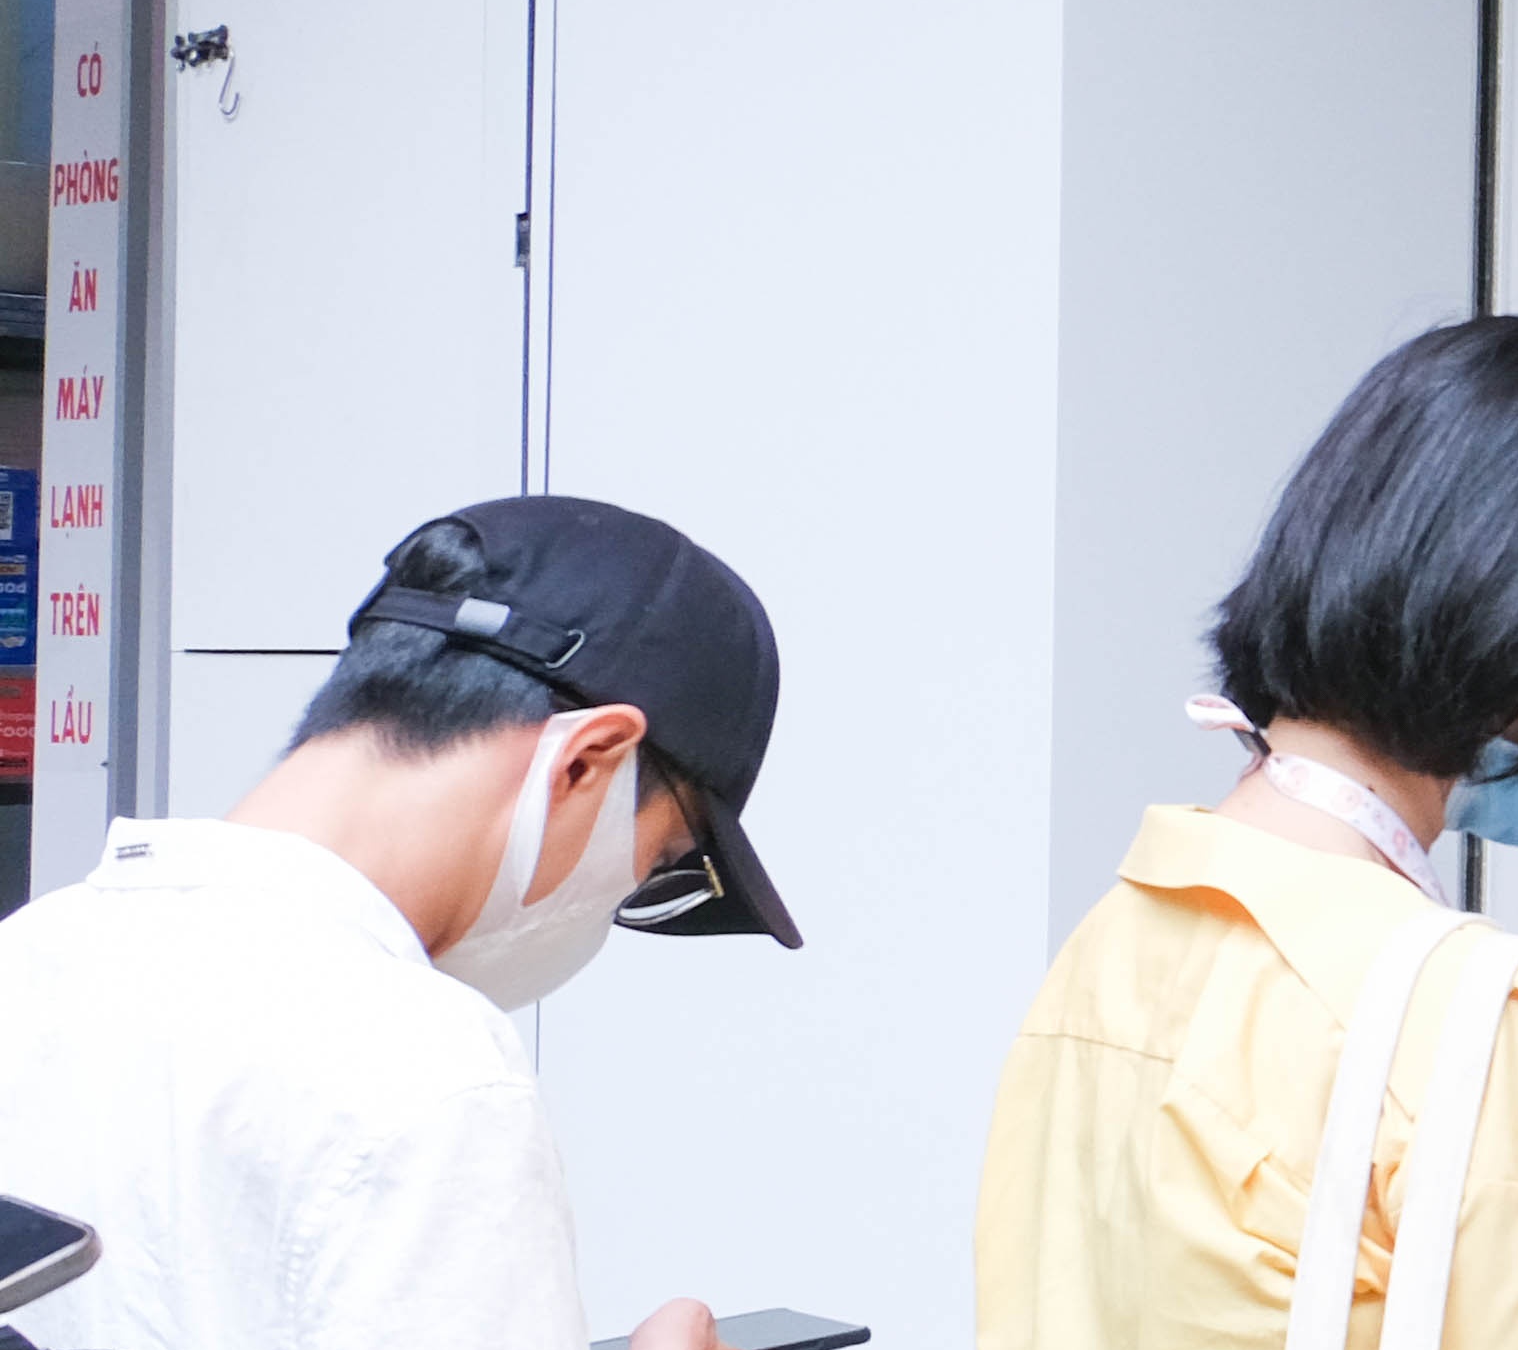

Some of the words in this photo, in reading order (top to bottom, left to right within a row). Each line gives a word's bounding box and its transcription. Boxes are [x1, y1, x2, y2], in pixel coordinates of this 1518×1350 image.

[76, 40, 104, 99] CÓ
[53, 148, 120, 209] PHÒNG
[68, 260, 98, 314] ĂN
[55, 371, 106, 423] MÁY
[49, 483, 105, 540] LẠNH
[49, 580, 102, 638] TRÊN
